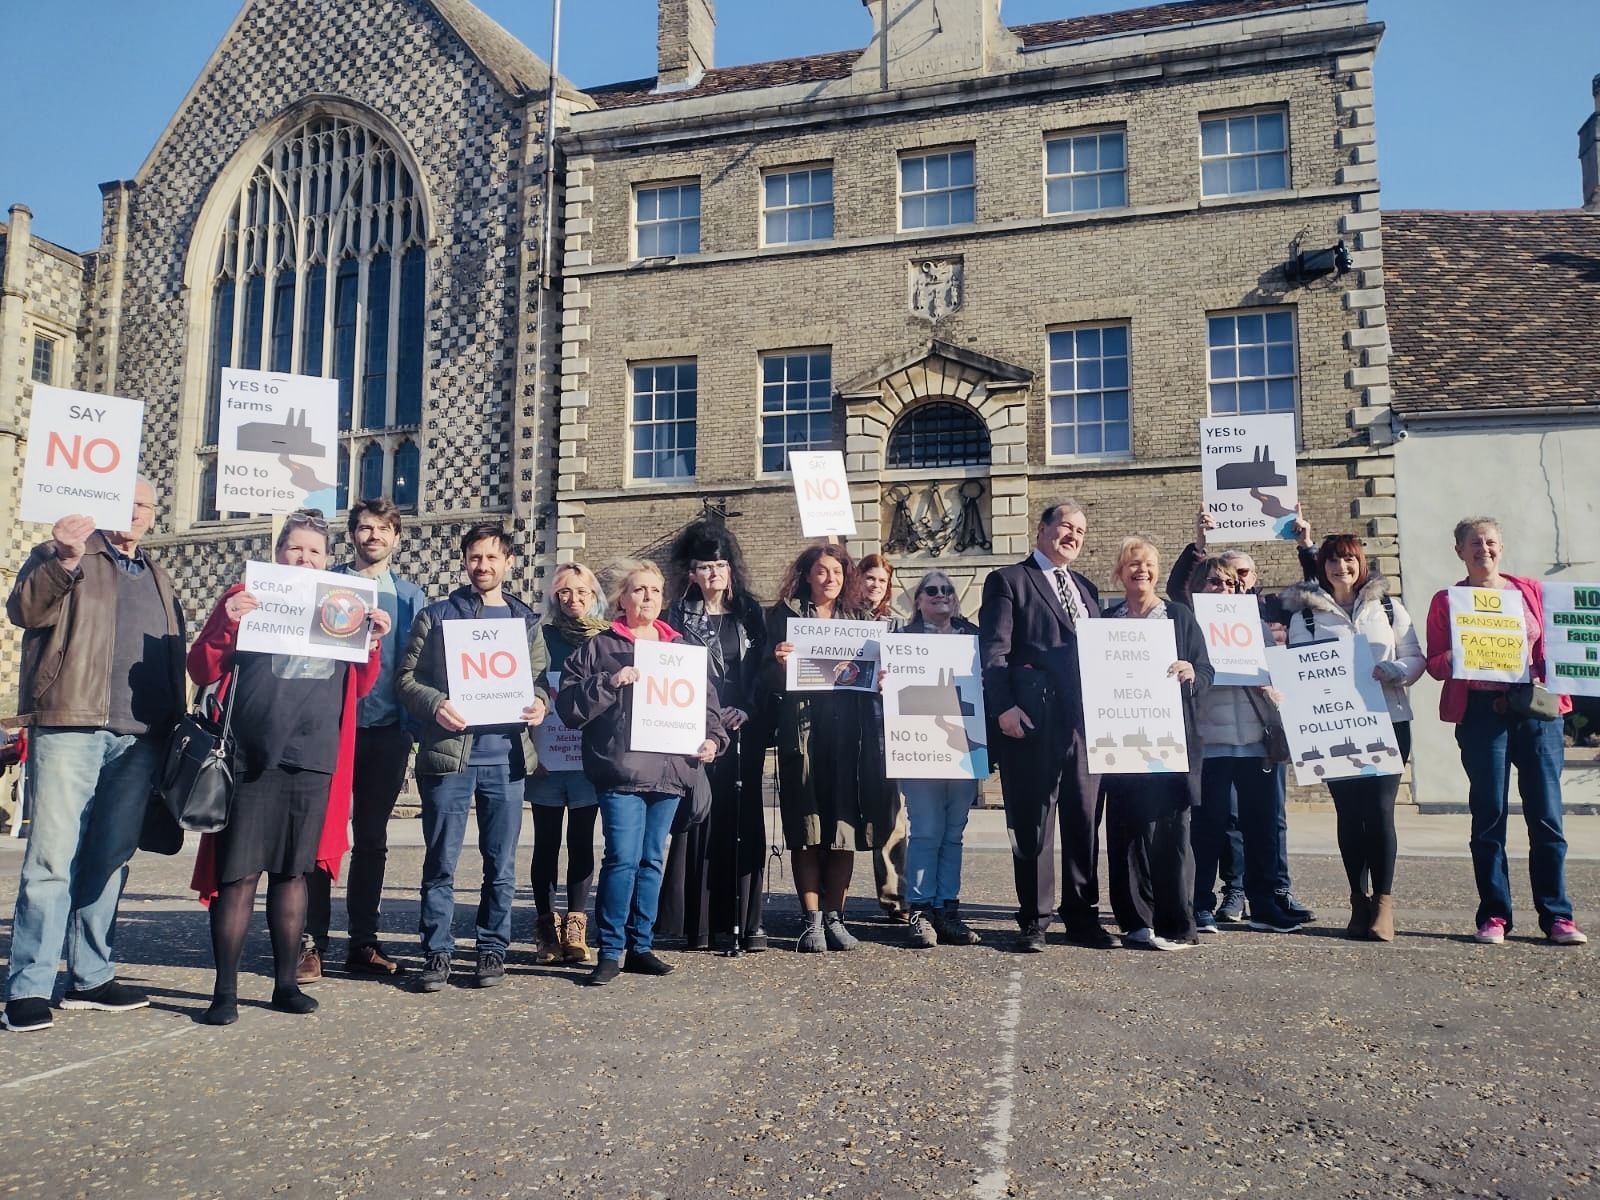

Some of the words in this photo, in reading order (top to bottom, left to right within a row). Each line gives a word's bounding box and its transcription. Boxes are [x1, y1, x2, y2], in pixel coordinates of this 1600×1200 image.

[228, 379, 259, 392] YES
[264, 383, 279, 394] to
[227, 397, 273, 412] farms
[69, 405, 106, 422] SAY
[1206, 427, 1231, 438] YES
[1233, 427, 1246, 436] to
[46, 431, 121, 474] NO
[1206, 444, 1242, 455] farms
[224, 464, 248, 476] NO
[253, 467, 269, 478] to
[37, 483, 53, 493] TO
[56, 485, 121, 501] CRANSWICK
[223, 483, 295, 499] factories
[803, 477, 841, 502] NO
[1209, 503, 1228, 513] NO
[1231, 503, 1244, 512] to
[1215, 517, 1266, 529] actories
[252, 580, 293, 594] SCRAP
[1474, 594, 1502, 609] NO
[1574, 590, 1600, 607] NO
[256, 601, 306, 617] ACTORY
[1216, 603, 1237, 614] SAY
[246, 620, 305, 637] FARMING
[1456, 616, 1521, 629] CRANSWICK
[472, 629, 499, 641] SAY
[793, 625, 831, 636] SCRAP
[834, 626, 882, 638] FACTORY
[1108, 631, 1147, 643] MEGA
[1208, 622, 1253, 648] NO
[1461, 634, 1524, 649] FACTORY
[810, 646, 864, 657] FARMING
[886, 644, 912, 656] YES
[916, 645, 929, 656] to
[1105, 650, 1151, 661] FARMS
[1298, 649, 1340, 664] MEGA
[461, 650, 517, 680] NO
[659, 653, 684, 667] SAY
[887, 662, 926, 675] farms
[1298, 665, 1347, 681] FARMS
[1555, 664, 1600, 676] METHW
[475, 691, 524, 700] CRANSWICK
[646, 675, 695, 708] NO
[1113, 688, 1152, 699] MEGA
[1097, 707, 1171, 719] POLLUTION
[1313, 700, 1354, 715] MEGA
[641, 718, 653, 727] TO
[653, 719, 697, 730] CRANSWICK
[1299, 715, 1378, 734] POLLUTION
[890, 730, 911, 742] NO
[915, 731, 928, 742] to
[891, 750, 952, 762] factories
